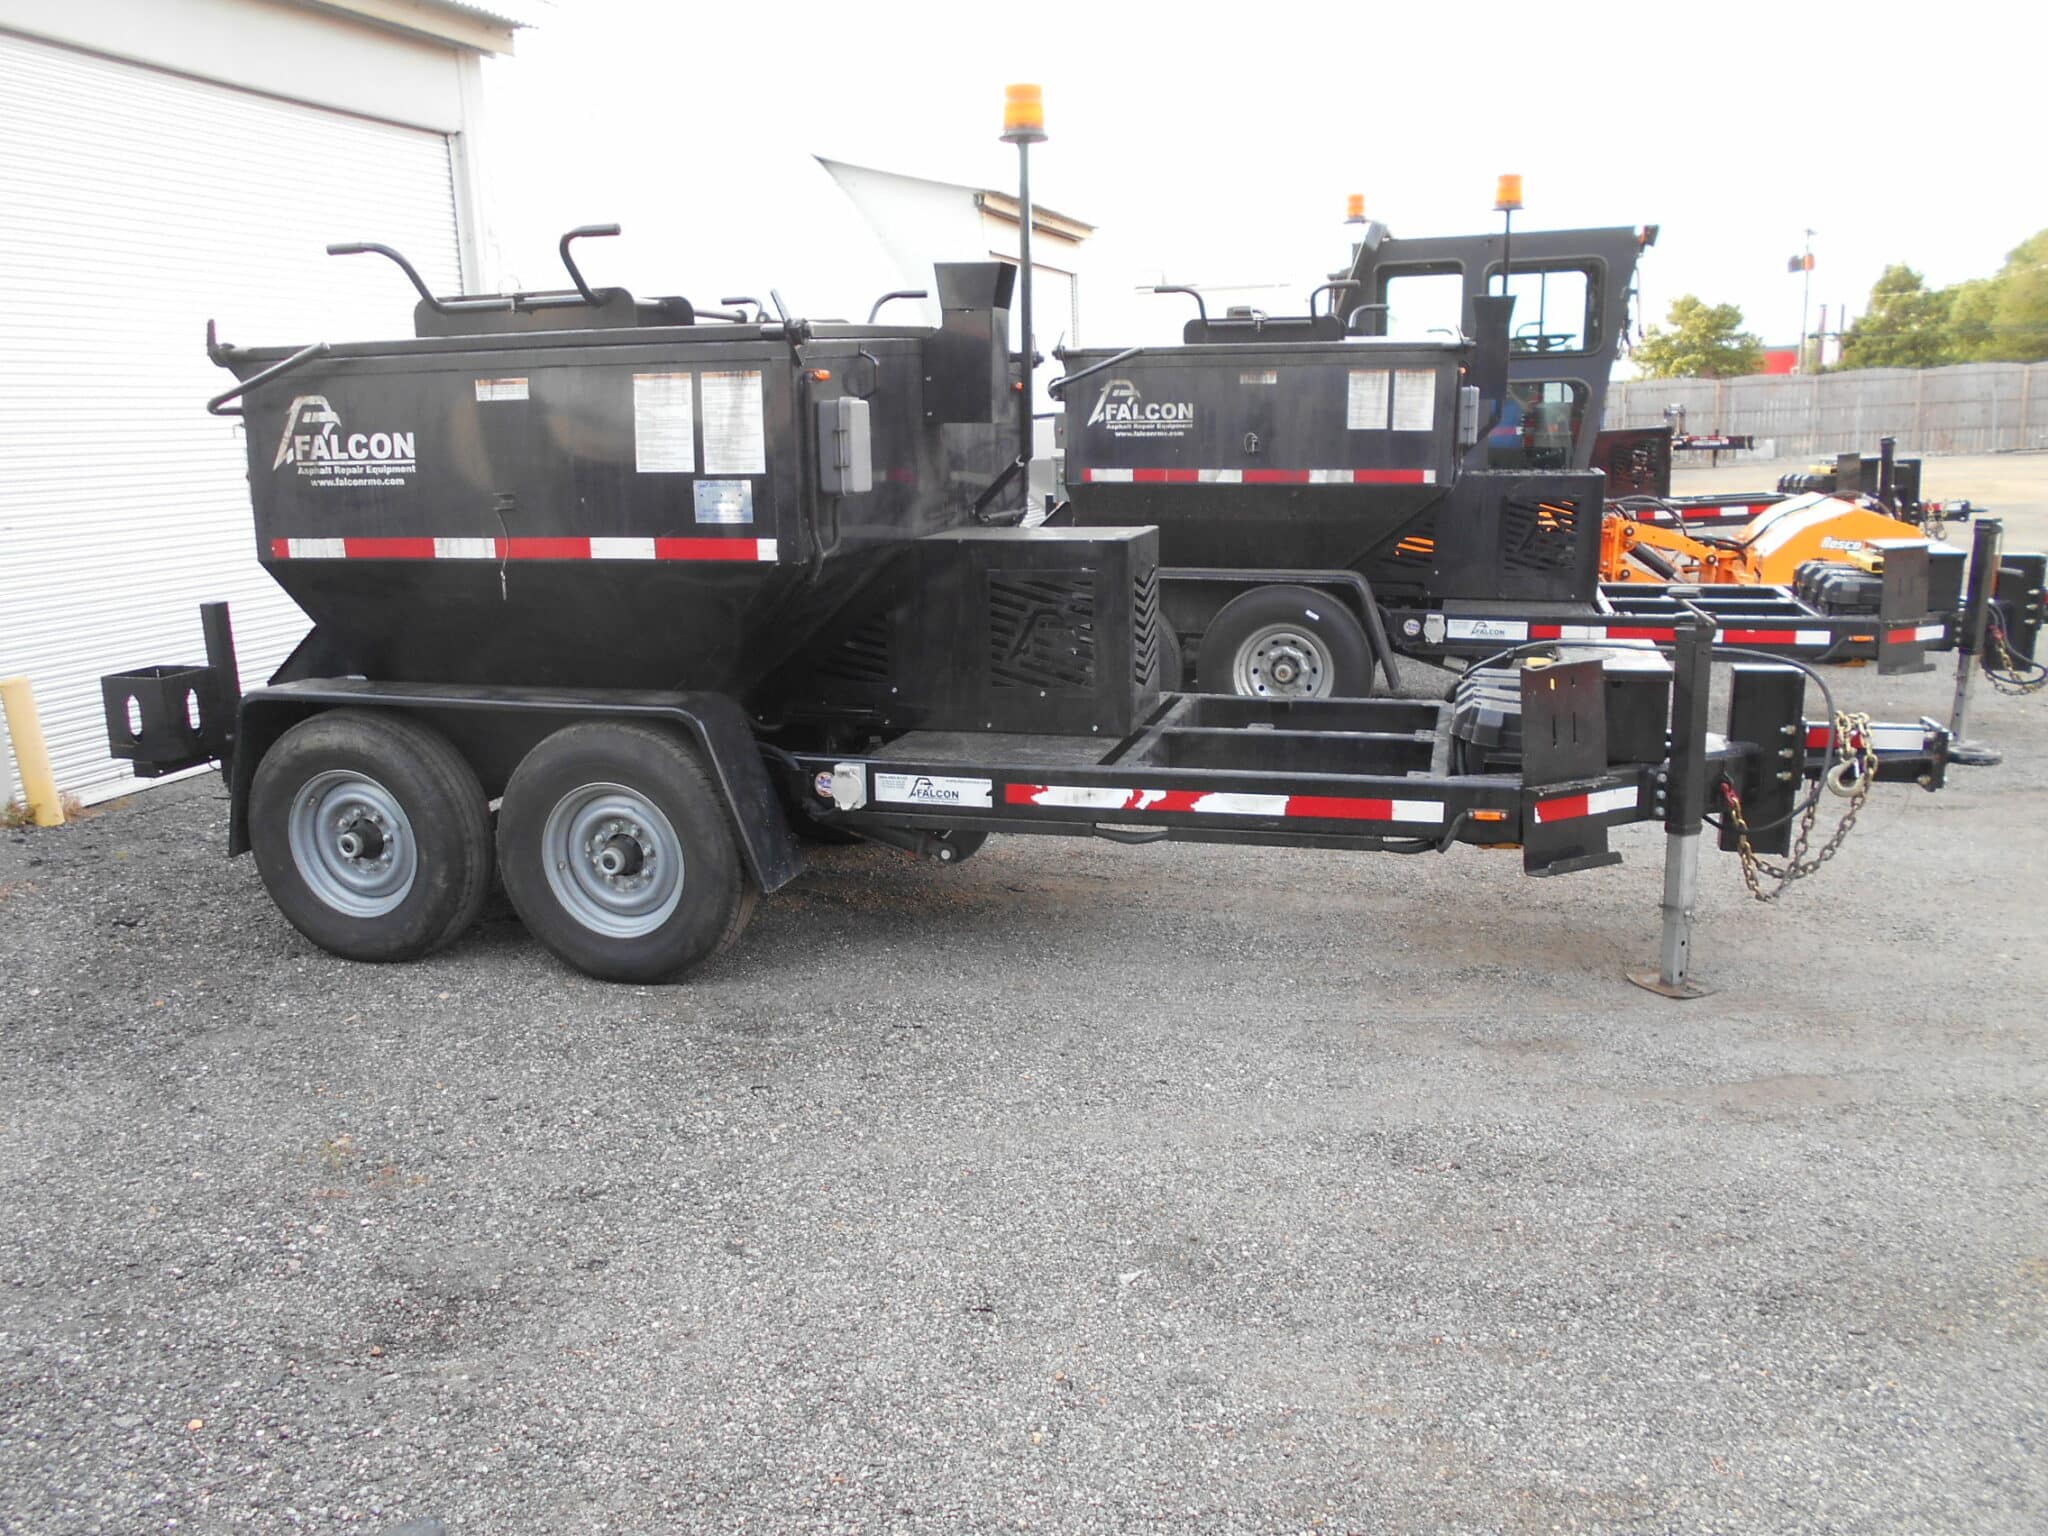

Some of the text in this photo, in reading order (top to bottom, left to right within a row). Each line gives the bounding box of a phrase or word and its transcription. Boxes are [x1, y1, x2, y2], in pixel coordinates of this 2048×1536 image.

[1106, 403, 1193, 420] FALCON
[294, 432, 415, 460] FALCON
[297, 464, 417, 475] Asphalt Repair Equipment
[916, 788, 960, 799] FALCON
